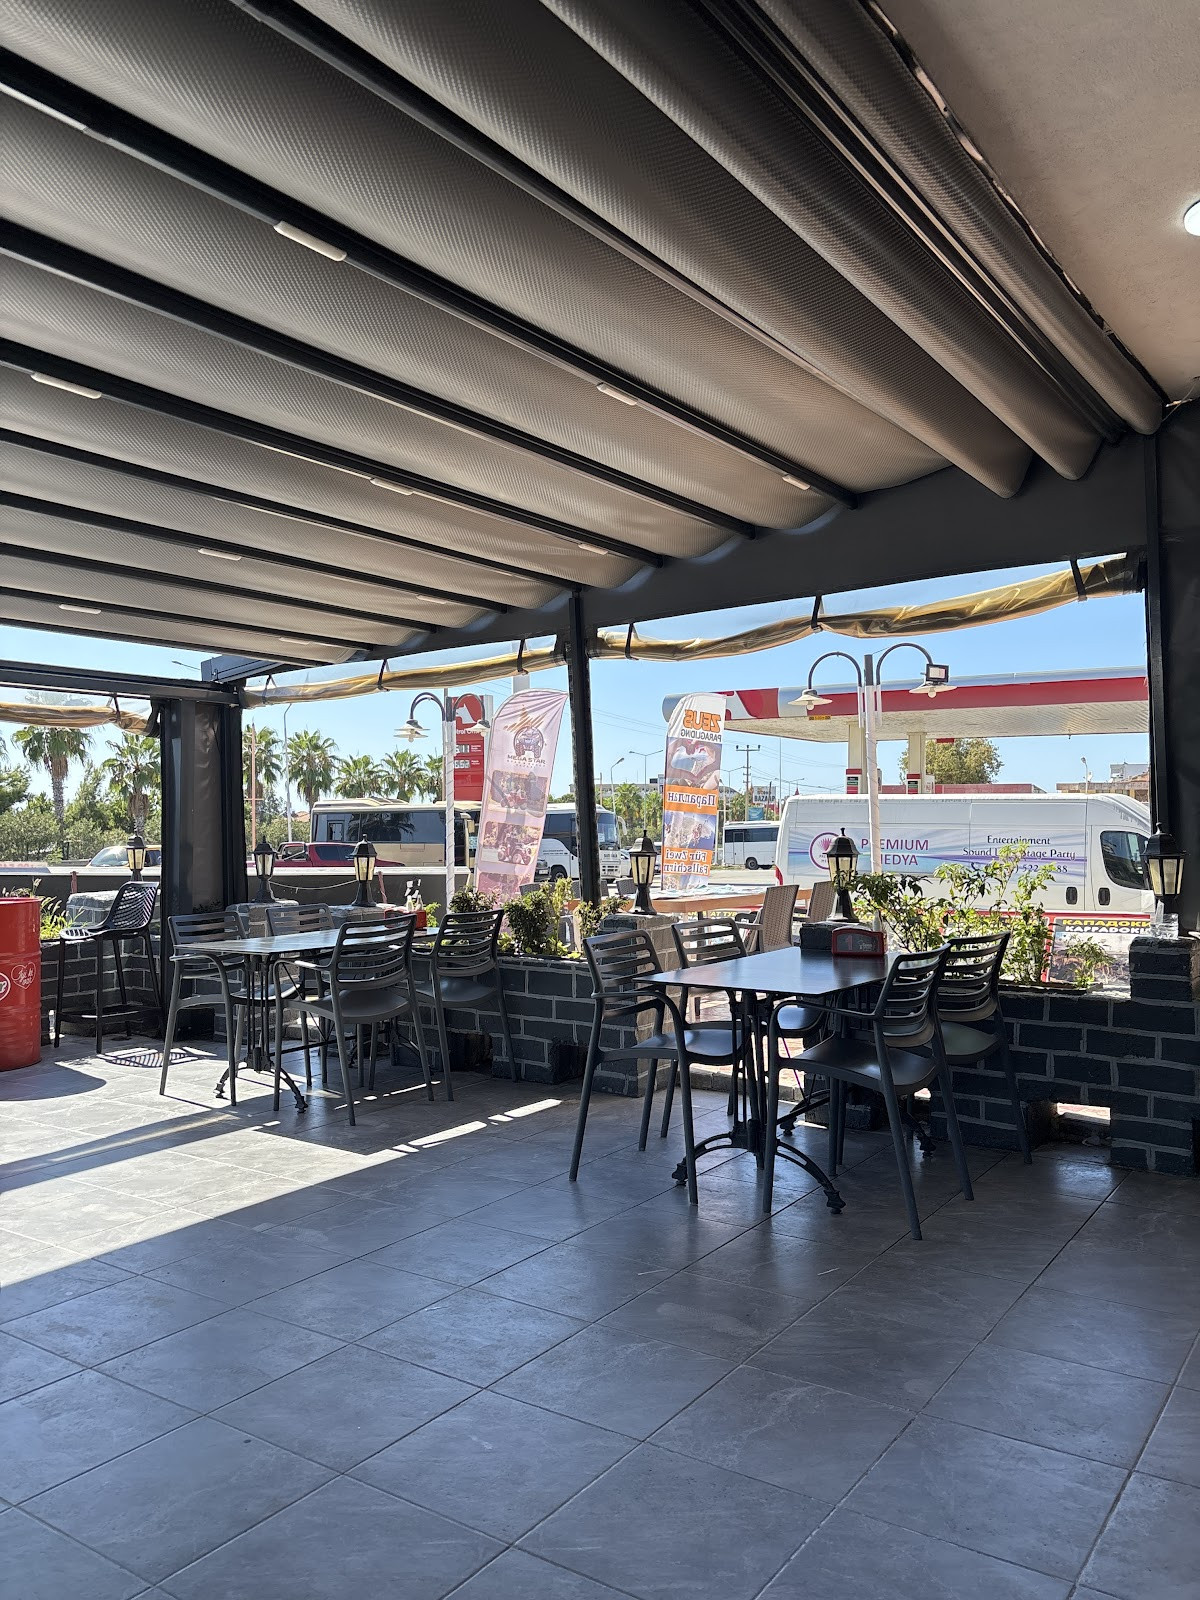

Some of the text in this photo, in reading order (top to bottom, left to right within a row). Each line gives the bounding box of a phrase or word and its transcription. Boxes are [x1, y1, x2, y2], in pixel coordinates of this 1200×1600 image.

[861, 838, 929, 851] PEMIUM
[987, 835, 1051, 845] Entertainment
[963, 847, 992, 857] Sound
[1050, 849, 1076, 860] Party
[880, 854, 918, 866] EDYA
